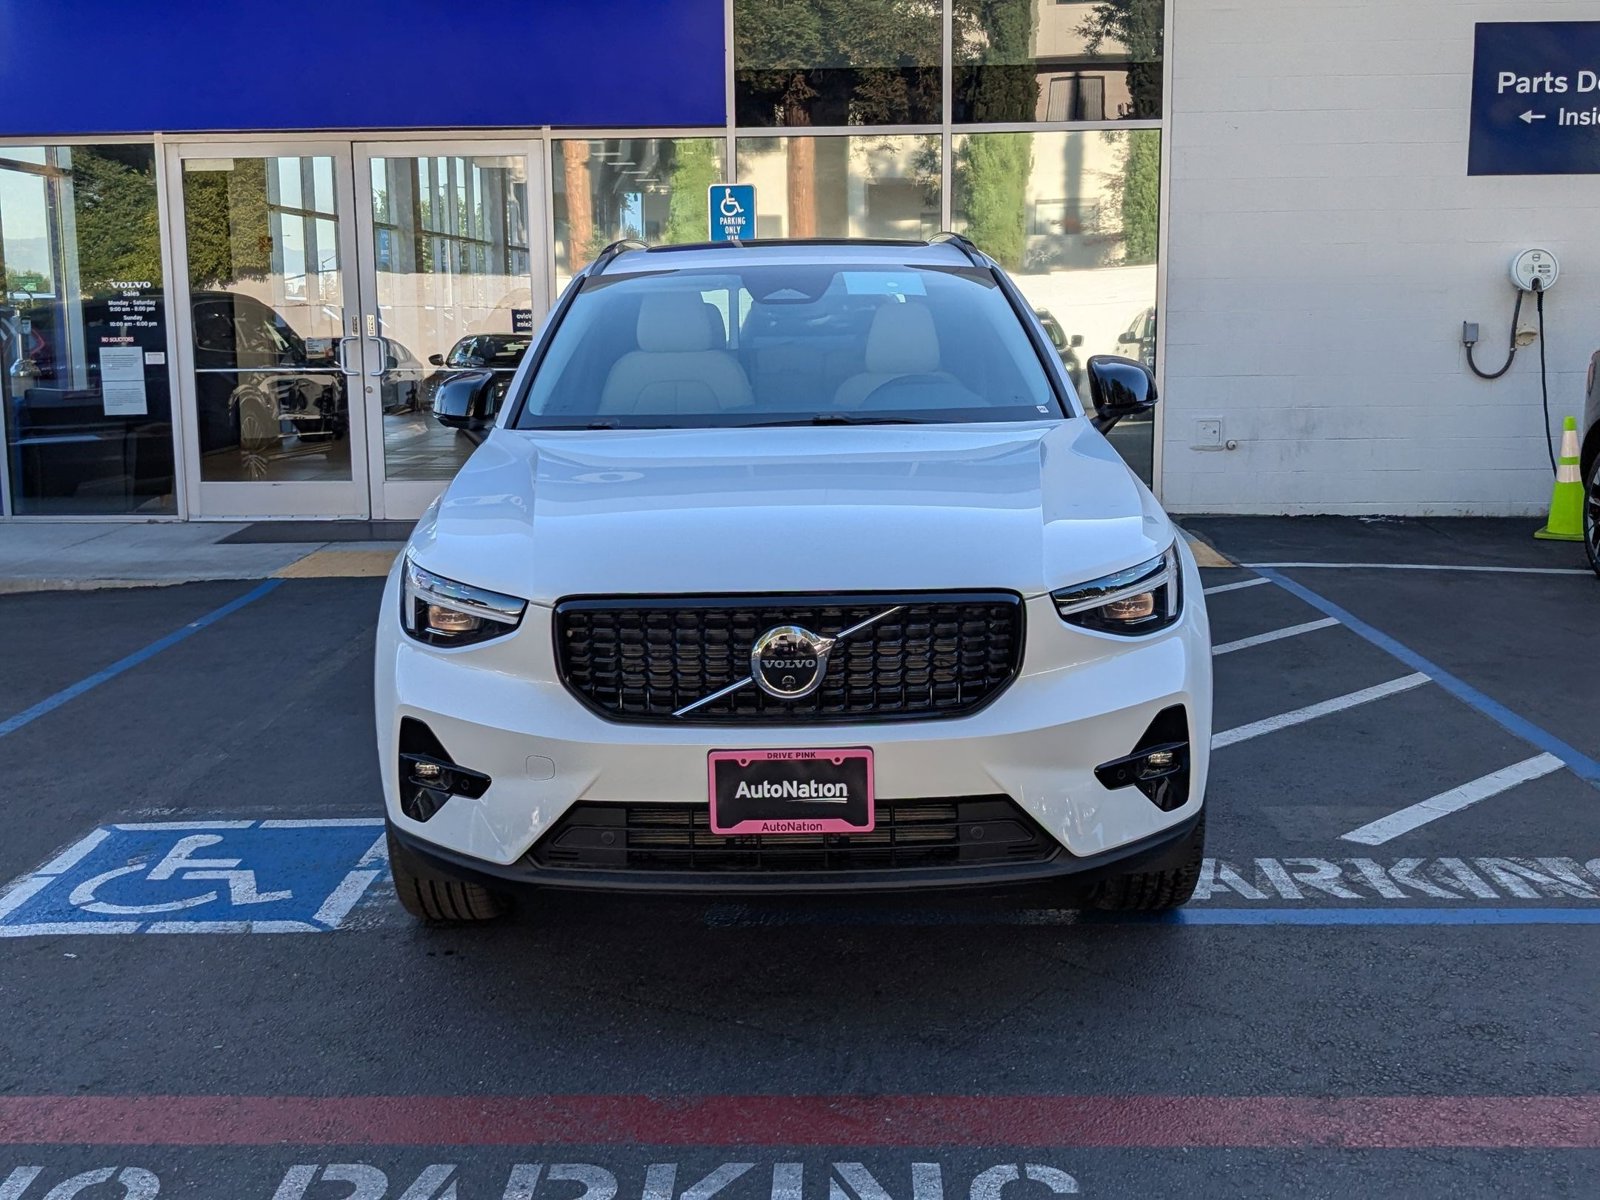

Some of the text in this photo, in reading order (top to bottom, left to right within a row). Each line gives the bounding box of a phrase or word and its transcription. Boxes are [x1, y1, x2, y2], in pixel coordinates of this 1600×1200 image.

[1498, 70, 1600, 94] Parts D
[1558, 107, 1600, 126] Insi
[720, 217, 746, 225] PARKING
[724, 226, 741, 234] ONLY
[111, 281, 151, 289] VOLVO
[762, 659, 816, 669] VOLVO
[767, 752, 793, 760] DRIVE
[735, 779, 848, 799] AutoNation
[761, 821, 823, 832] AutoNation
